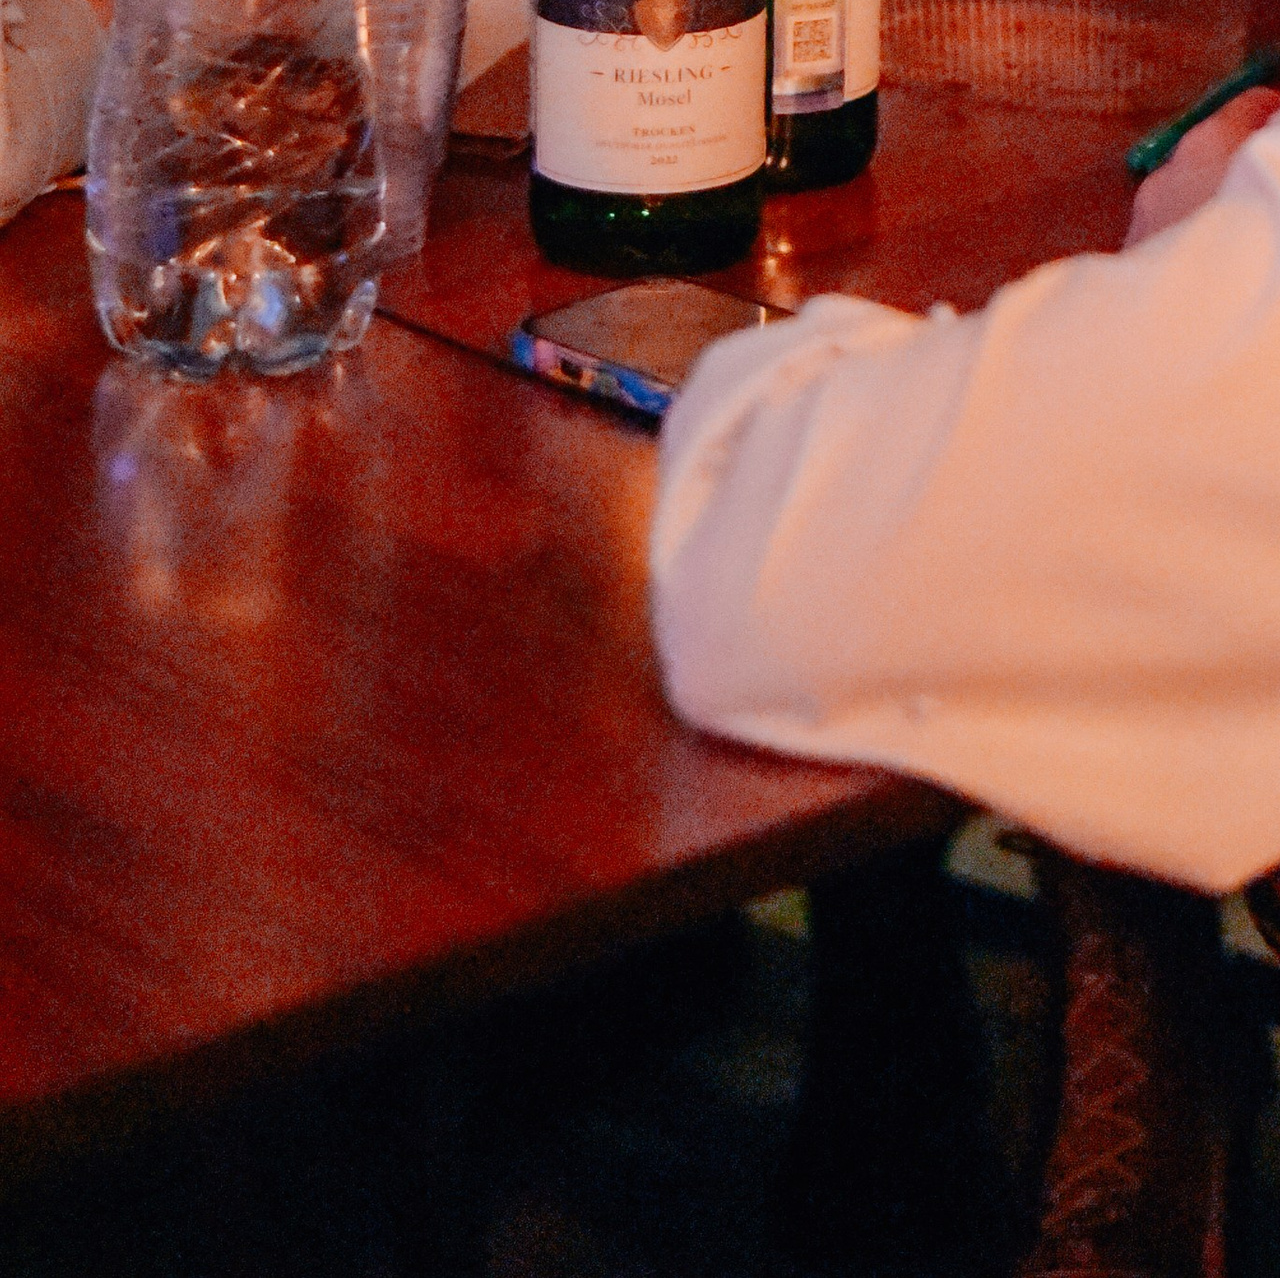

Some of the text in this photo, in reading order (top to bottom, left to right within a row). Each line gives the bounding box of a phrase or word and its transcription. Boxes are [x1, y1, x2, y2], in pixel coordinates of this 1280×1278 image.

[614, 65, 713, 83] RIESLING
[638, 89, 692, 106] Mosel
[633, 125, 696, 137] TROCKEN
